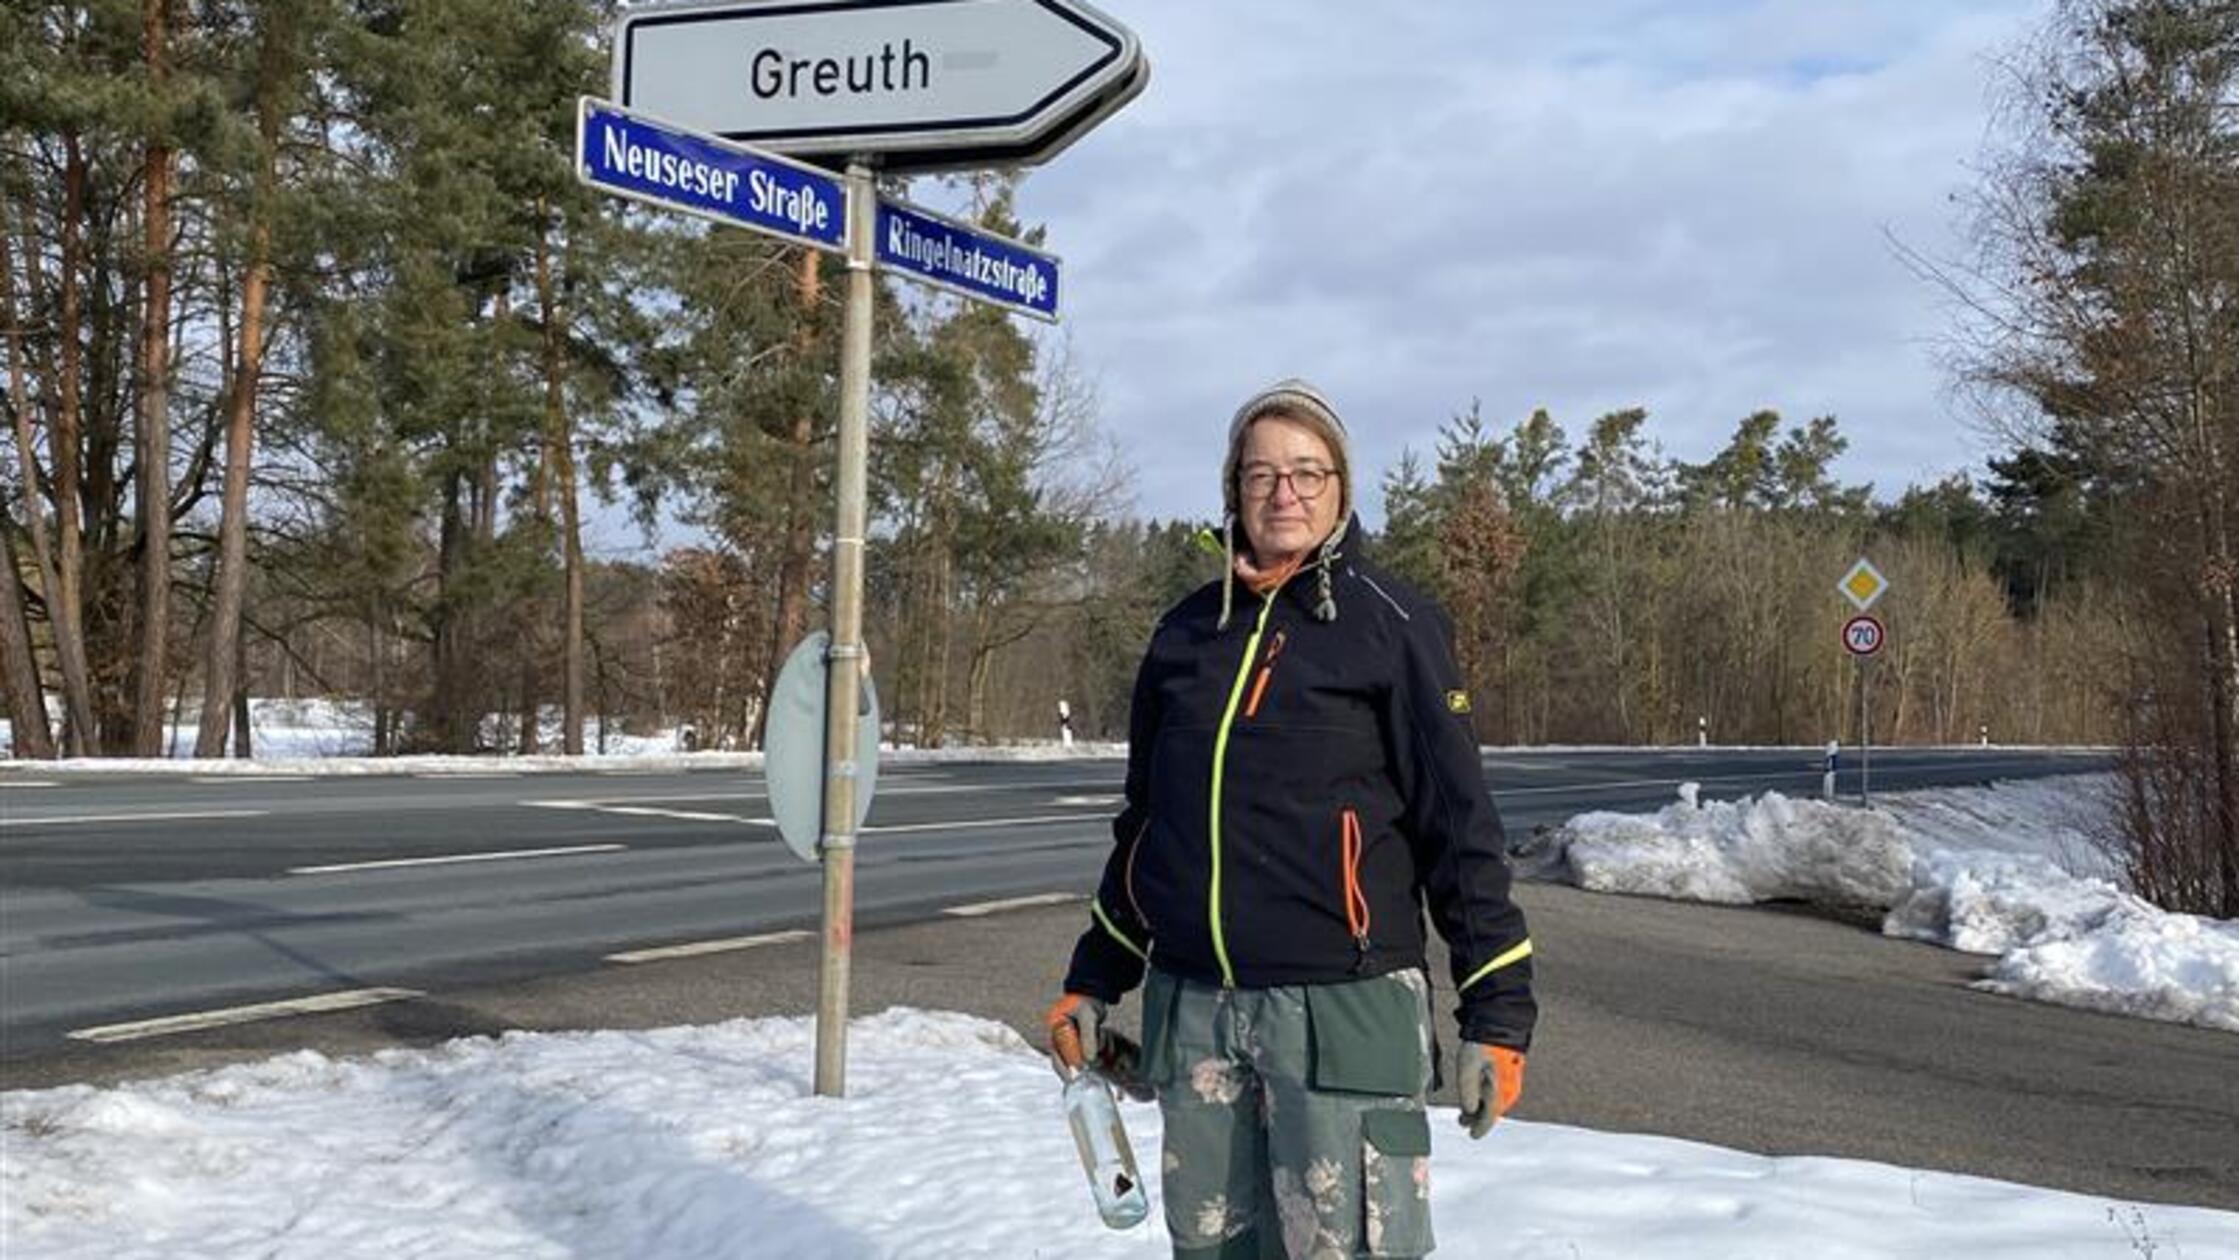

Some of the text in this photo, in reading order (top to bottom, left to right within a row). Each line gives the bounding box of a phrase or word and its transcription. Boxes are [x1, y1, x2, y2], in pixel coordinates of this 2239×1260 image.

[751, 39, 930, 99] Greuth
[603, 124, 828, 233] Neuseser Straße
[888, 215, 1046, 304] Ringelnatzstraße
[1851, 626, 1875, 645] 70
